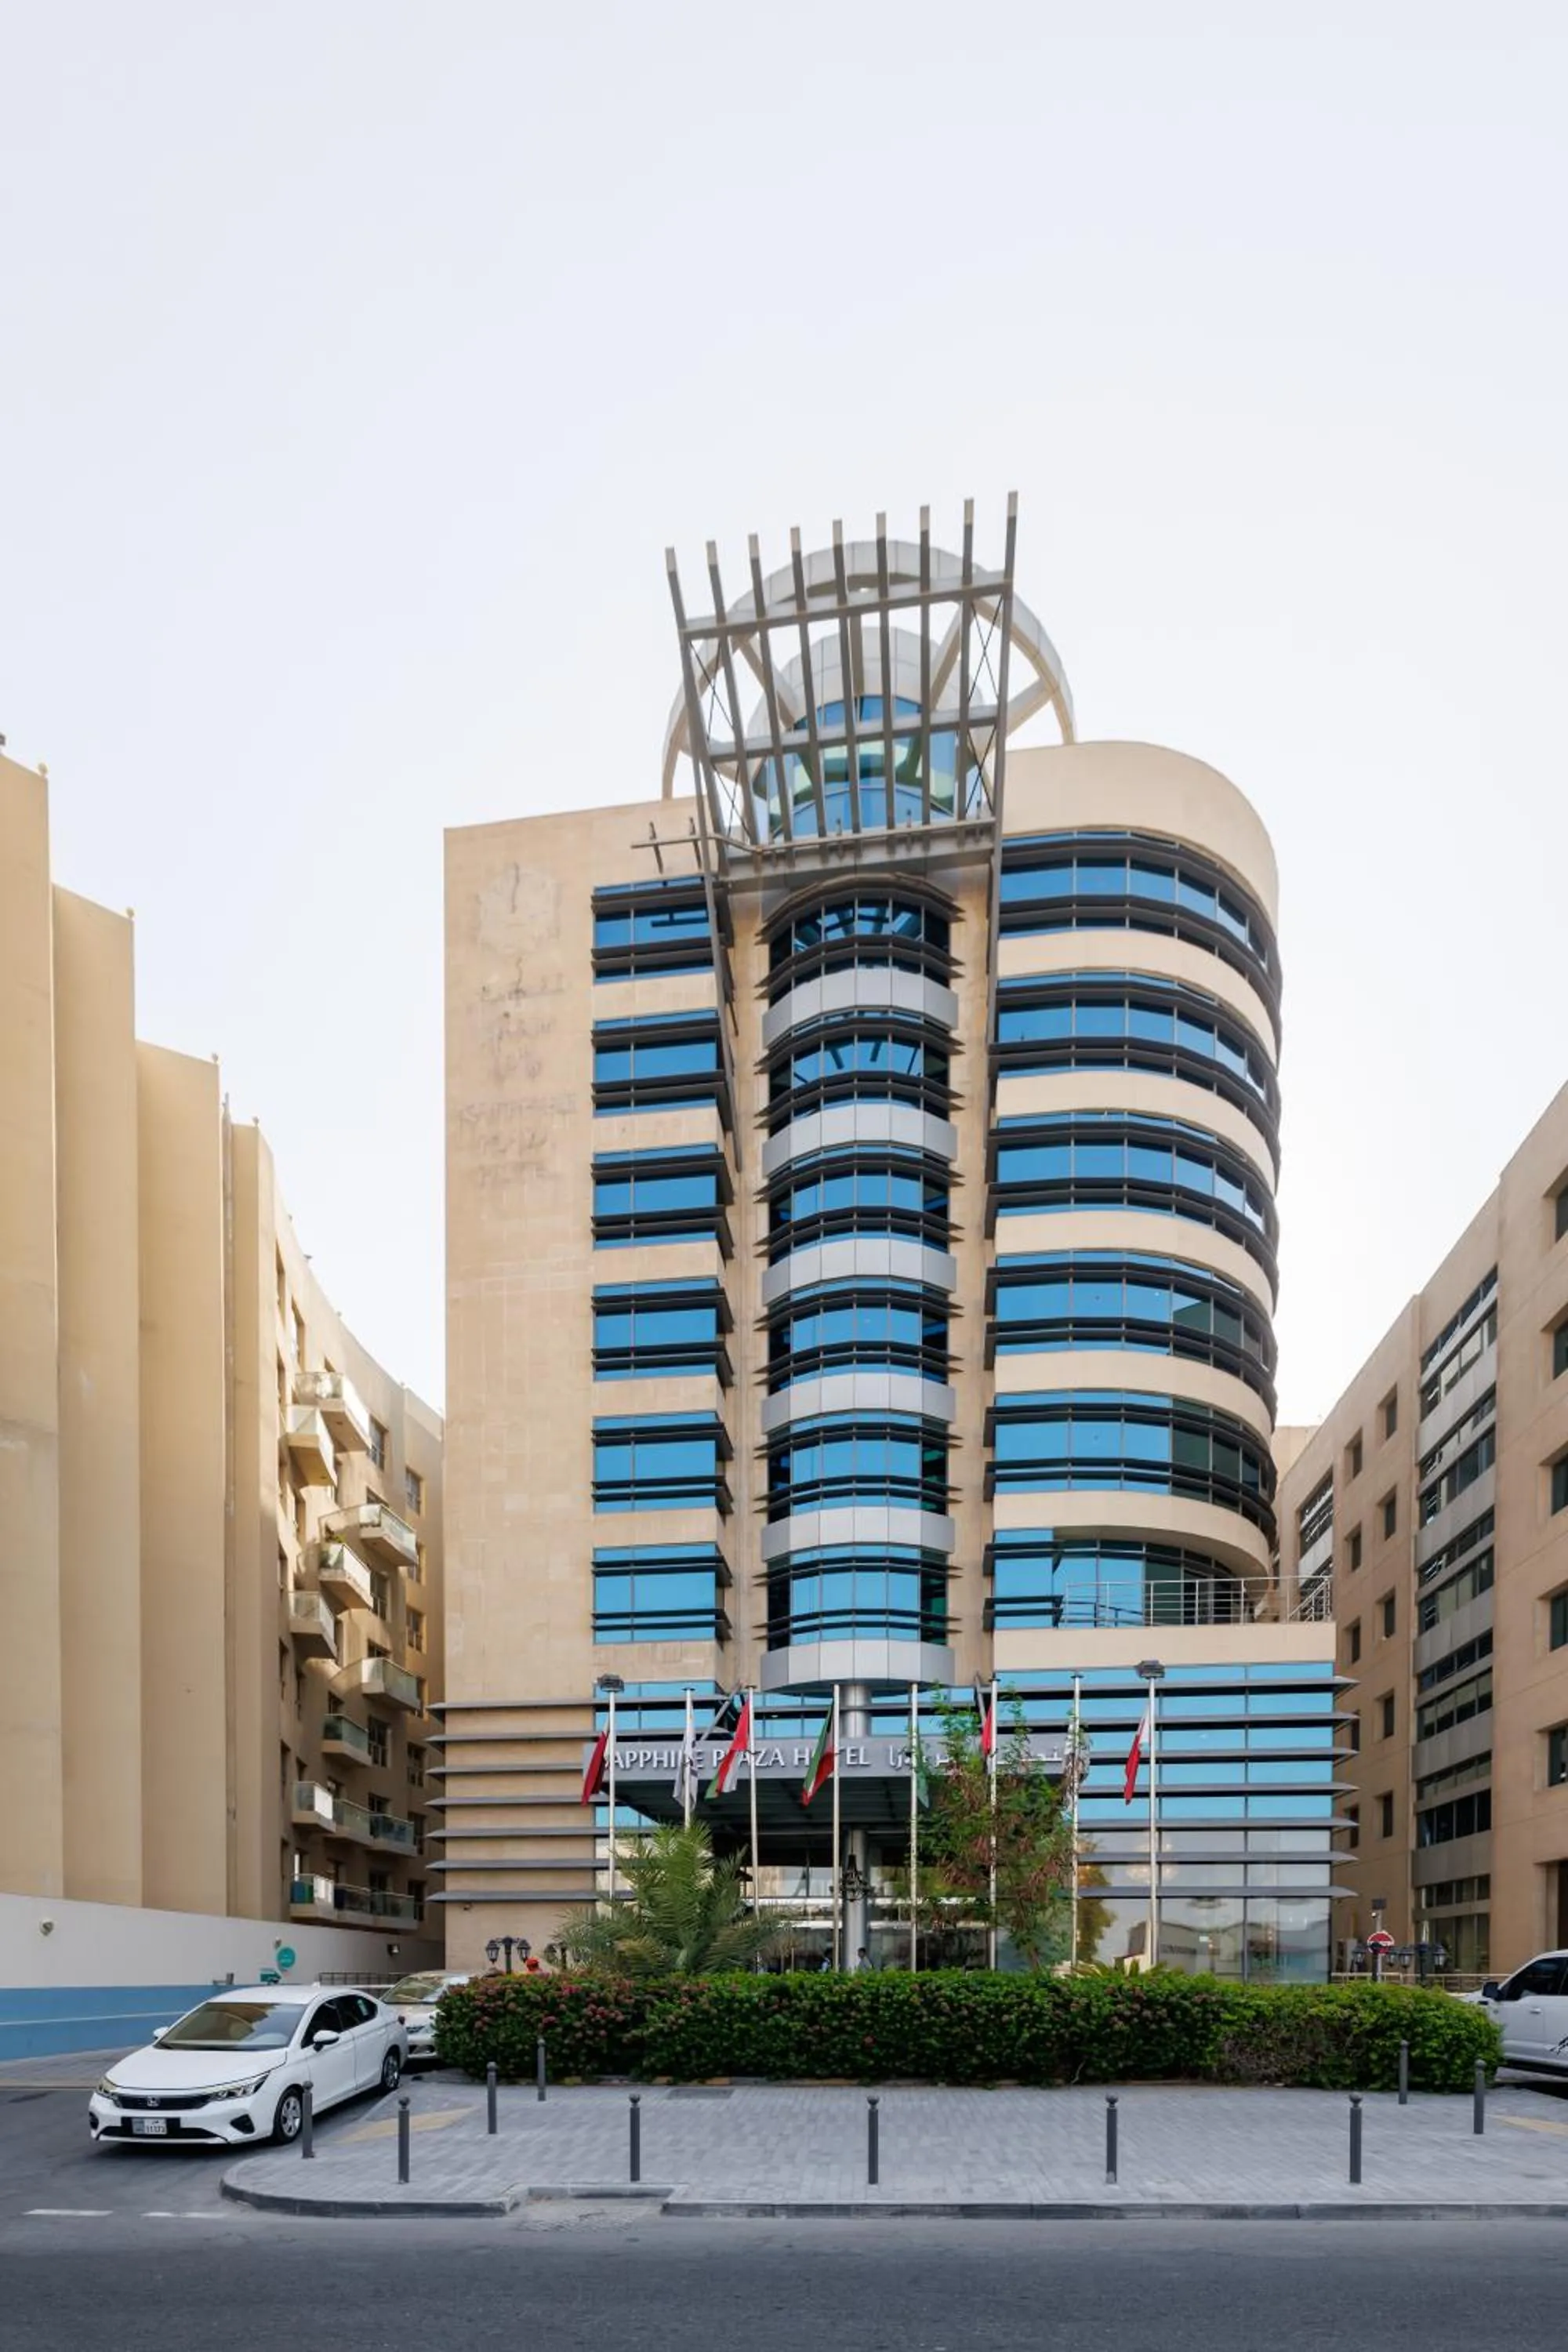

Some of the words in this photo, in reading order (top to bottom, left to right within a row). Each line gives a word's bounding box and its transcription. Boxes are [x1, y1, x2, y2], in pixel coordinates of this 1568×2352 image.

[604, 1749, 704, 1769] APPHIE
[712, 1747, 785, 1768] PAZA
[794, 1745, 869, 1766] HEL
